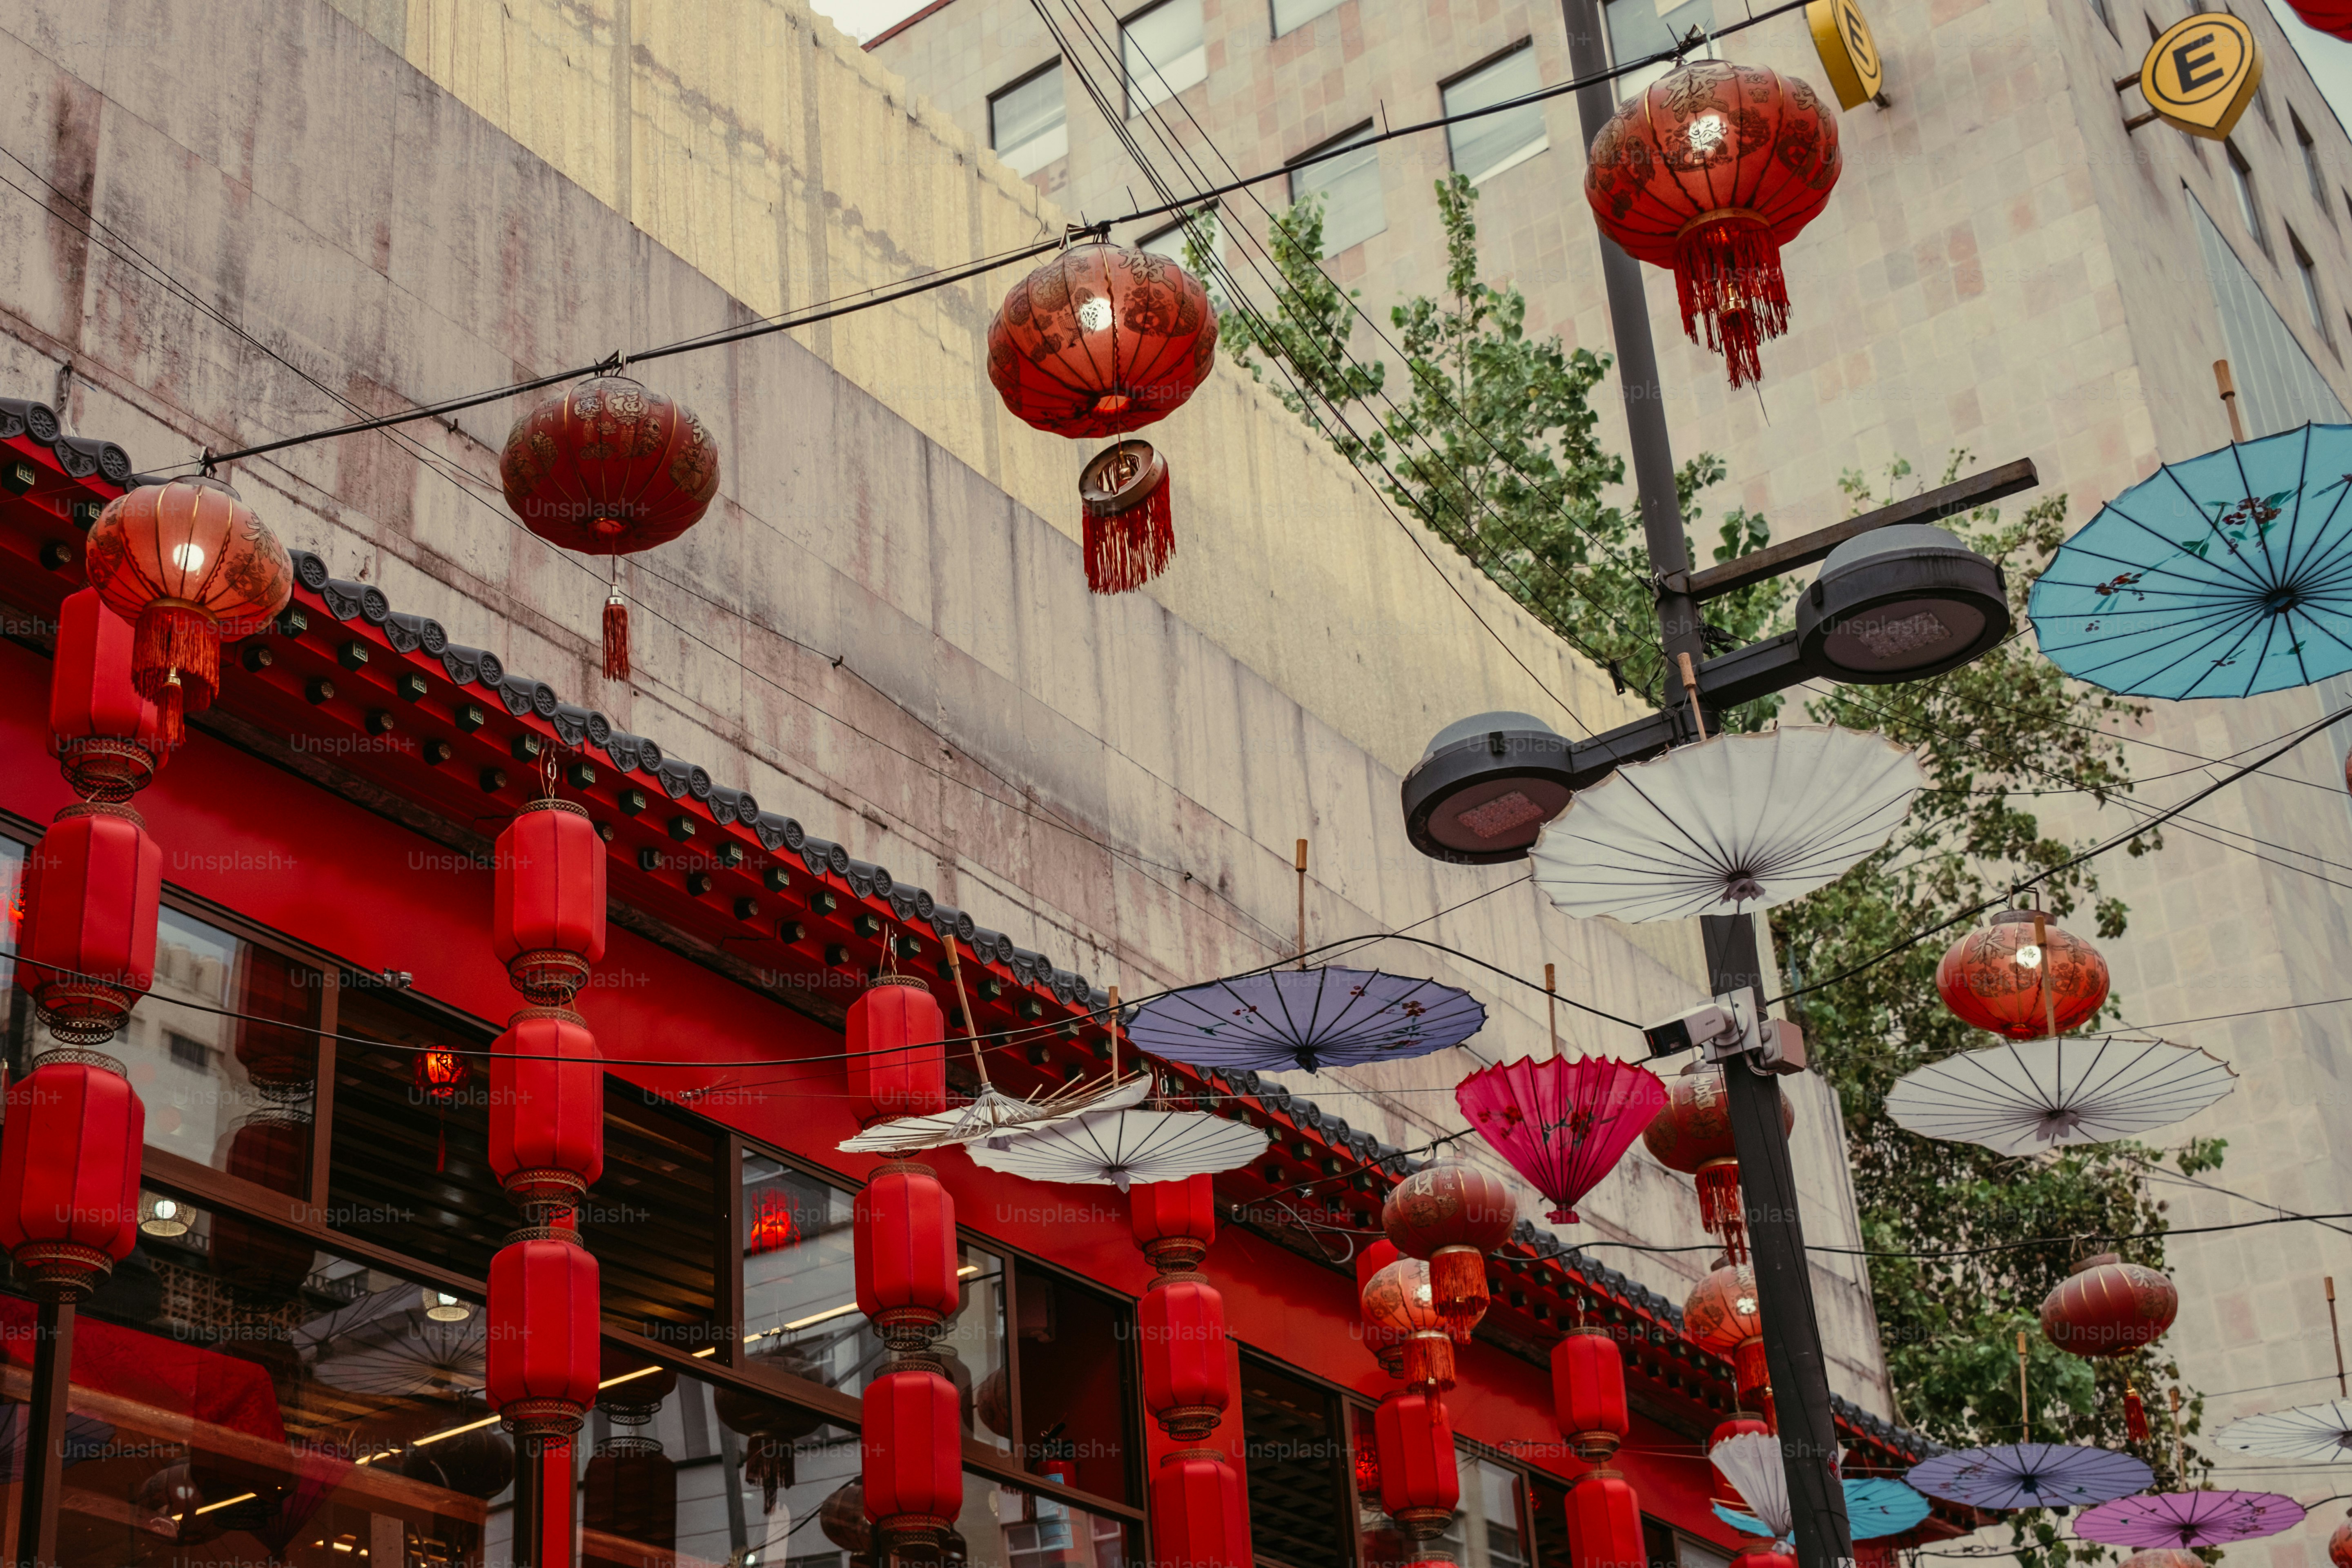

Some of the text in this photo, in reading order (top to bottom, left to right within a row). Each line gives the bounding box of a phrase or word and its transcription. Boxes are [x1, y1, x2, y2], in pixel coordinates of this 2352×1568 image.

[1844, 4, 1870, 67] E
[2172, 32, 2224, 94] E
[610, 390, 644, 412] 福
